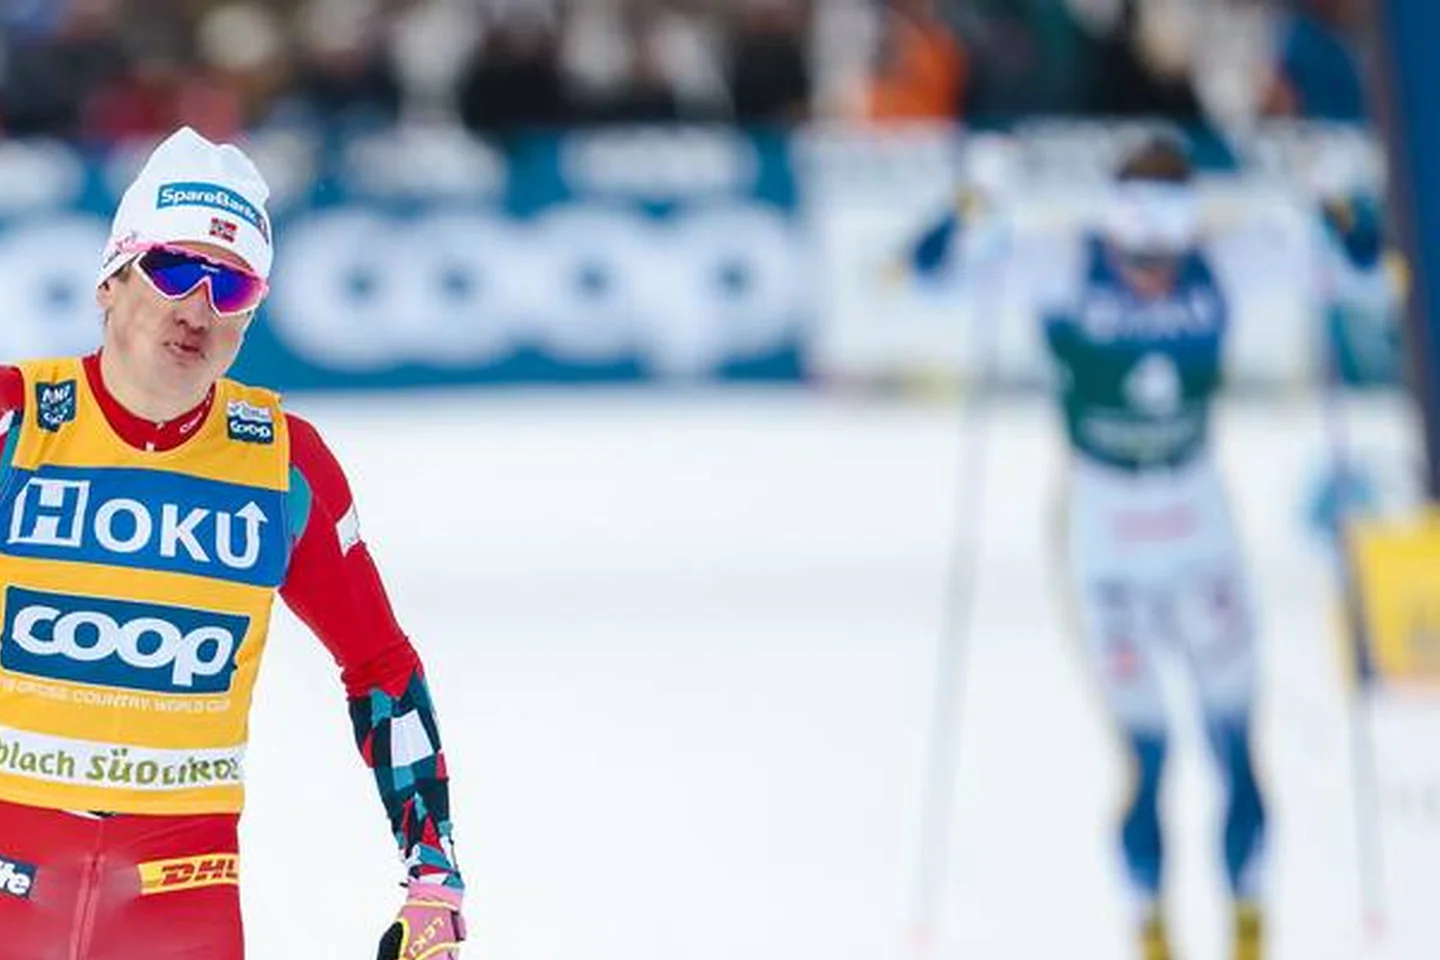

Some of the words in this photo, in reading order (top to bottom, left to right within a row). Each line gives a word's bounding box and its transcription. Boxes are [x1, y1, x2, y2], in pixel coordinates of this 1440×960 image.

[266, 200, 800, 385] coop
[7, 476, 268, 569] HOKU
[12, 605, 234, 687] coop
[160, 858, 239, 886] DHL
